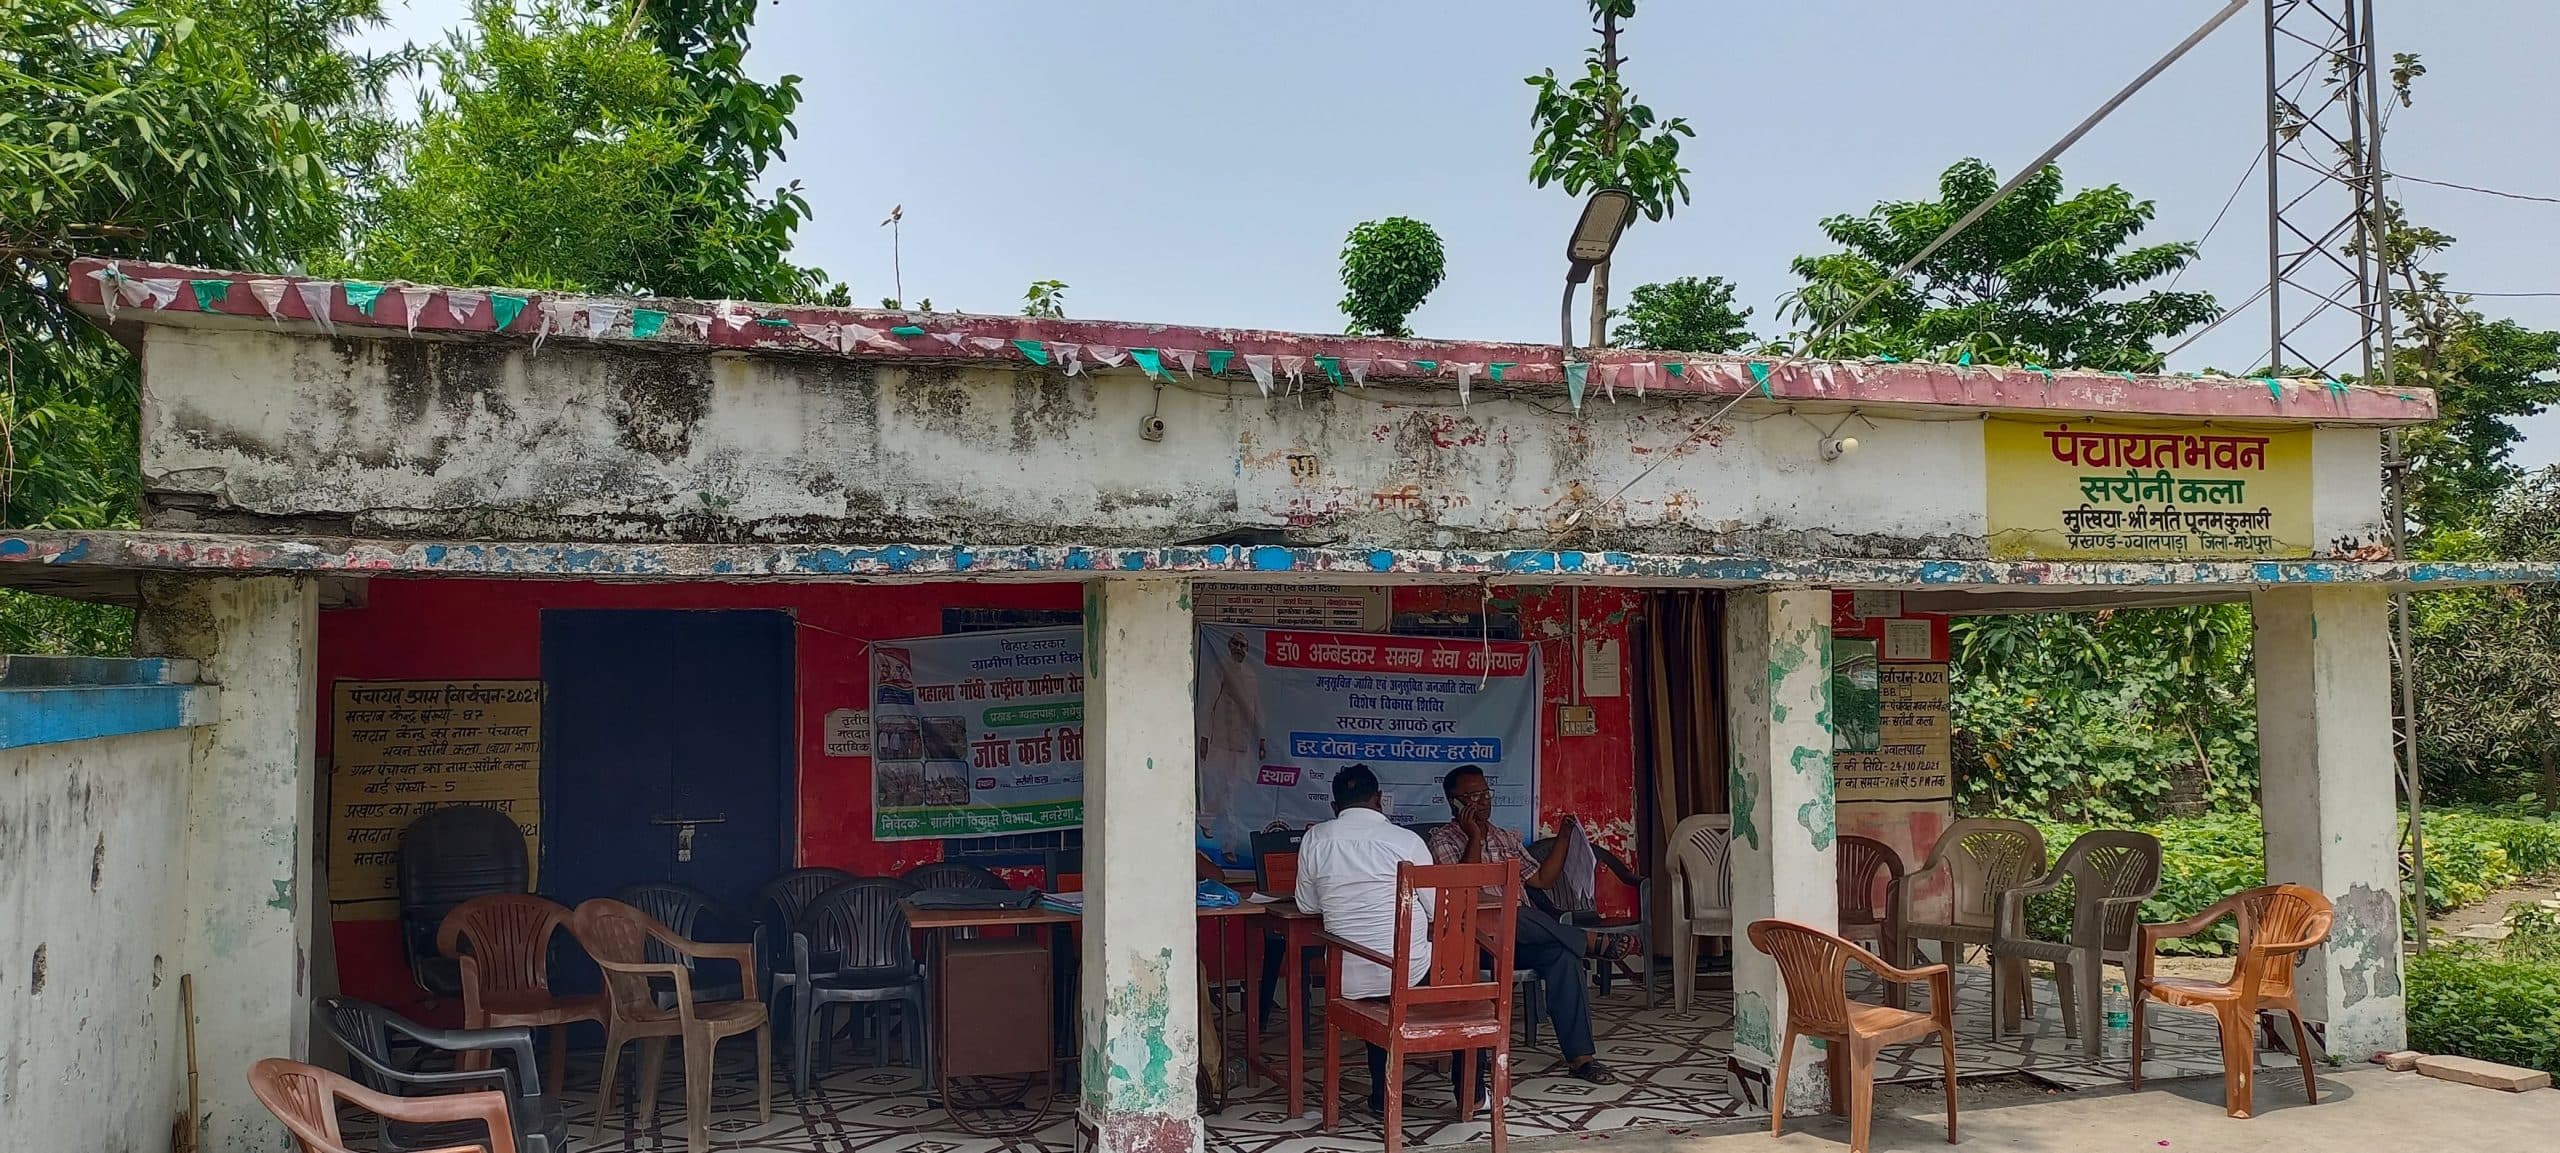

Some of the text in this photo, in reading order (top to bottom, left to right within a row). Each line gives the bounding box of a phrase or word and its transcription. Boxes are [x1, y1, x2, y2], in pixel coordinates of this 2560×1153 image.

[2079, 469, 2245, 504] सरौनी कला
[1001, 639, 1066, 652] बिहार सरकार
[1308, 636, 1376, 665] अम्बेडकर
[1384, 647, 1424, 669] समग्र
[1431, 642, 1461, 669] सेवा
[971, 651, 1083, 671] ग्रामीण विकास विभ
[1354, 676, 1374, 690] जाति
[1425, 680, 1457, 694] जनजाति
[1459, 681, 1477, 694] टोला
[1880, 667, 1943, 685] र्वाचन-2021
[349, 686, 404, 704] पंचायत
[917, 684, 955, 702] महात्मा
[990, 677, 1025, 701] राष्ट्रीय
[1027, 674, 1065, 697] ग्रामीण
[1349, 693, 1445, 712] विशेष विकास शिविर
[487, 723, 532, 737] पंचायत
[1336, 716, 1457, 733] सरकार आपके द्वार
[453, 743, 481, 756] कला
[828, 740, 872, 753] पदाधिक
[970, 726, 1084, 769] जॉब कार्ड शि
[1296, 739, 1319, 755] हर
[1468, 742, 1494, 760] सेवा
[377, 762, 419, 776] पंचायत
[422, 763, 441, 775] का
[502, 760, 530, 772] कला
[1844, 758, 1858, 772] की
[1260, 768, 1297, 785] स्थान
[1845, 777, 1857, 789] का
[364, 776, 389, 796] वार्ड
[444, 781, 457, 793] 5
[343, 803, 386, 818] प्रखण्ड
[389, 803, 412, 817] का
[930, 812, 965, 829] ग्रामीण
[967, 810, 999, 827] विकास
[347, 827, 395, 843] मतदान
